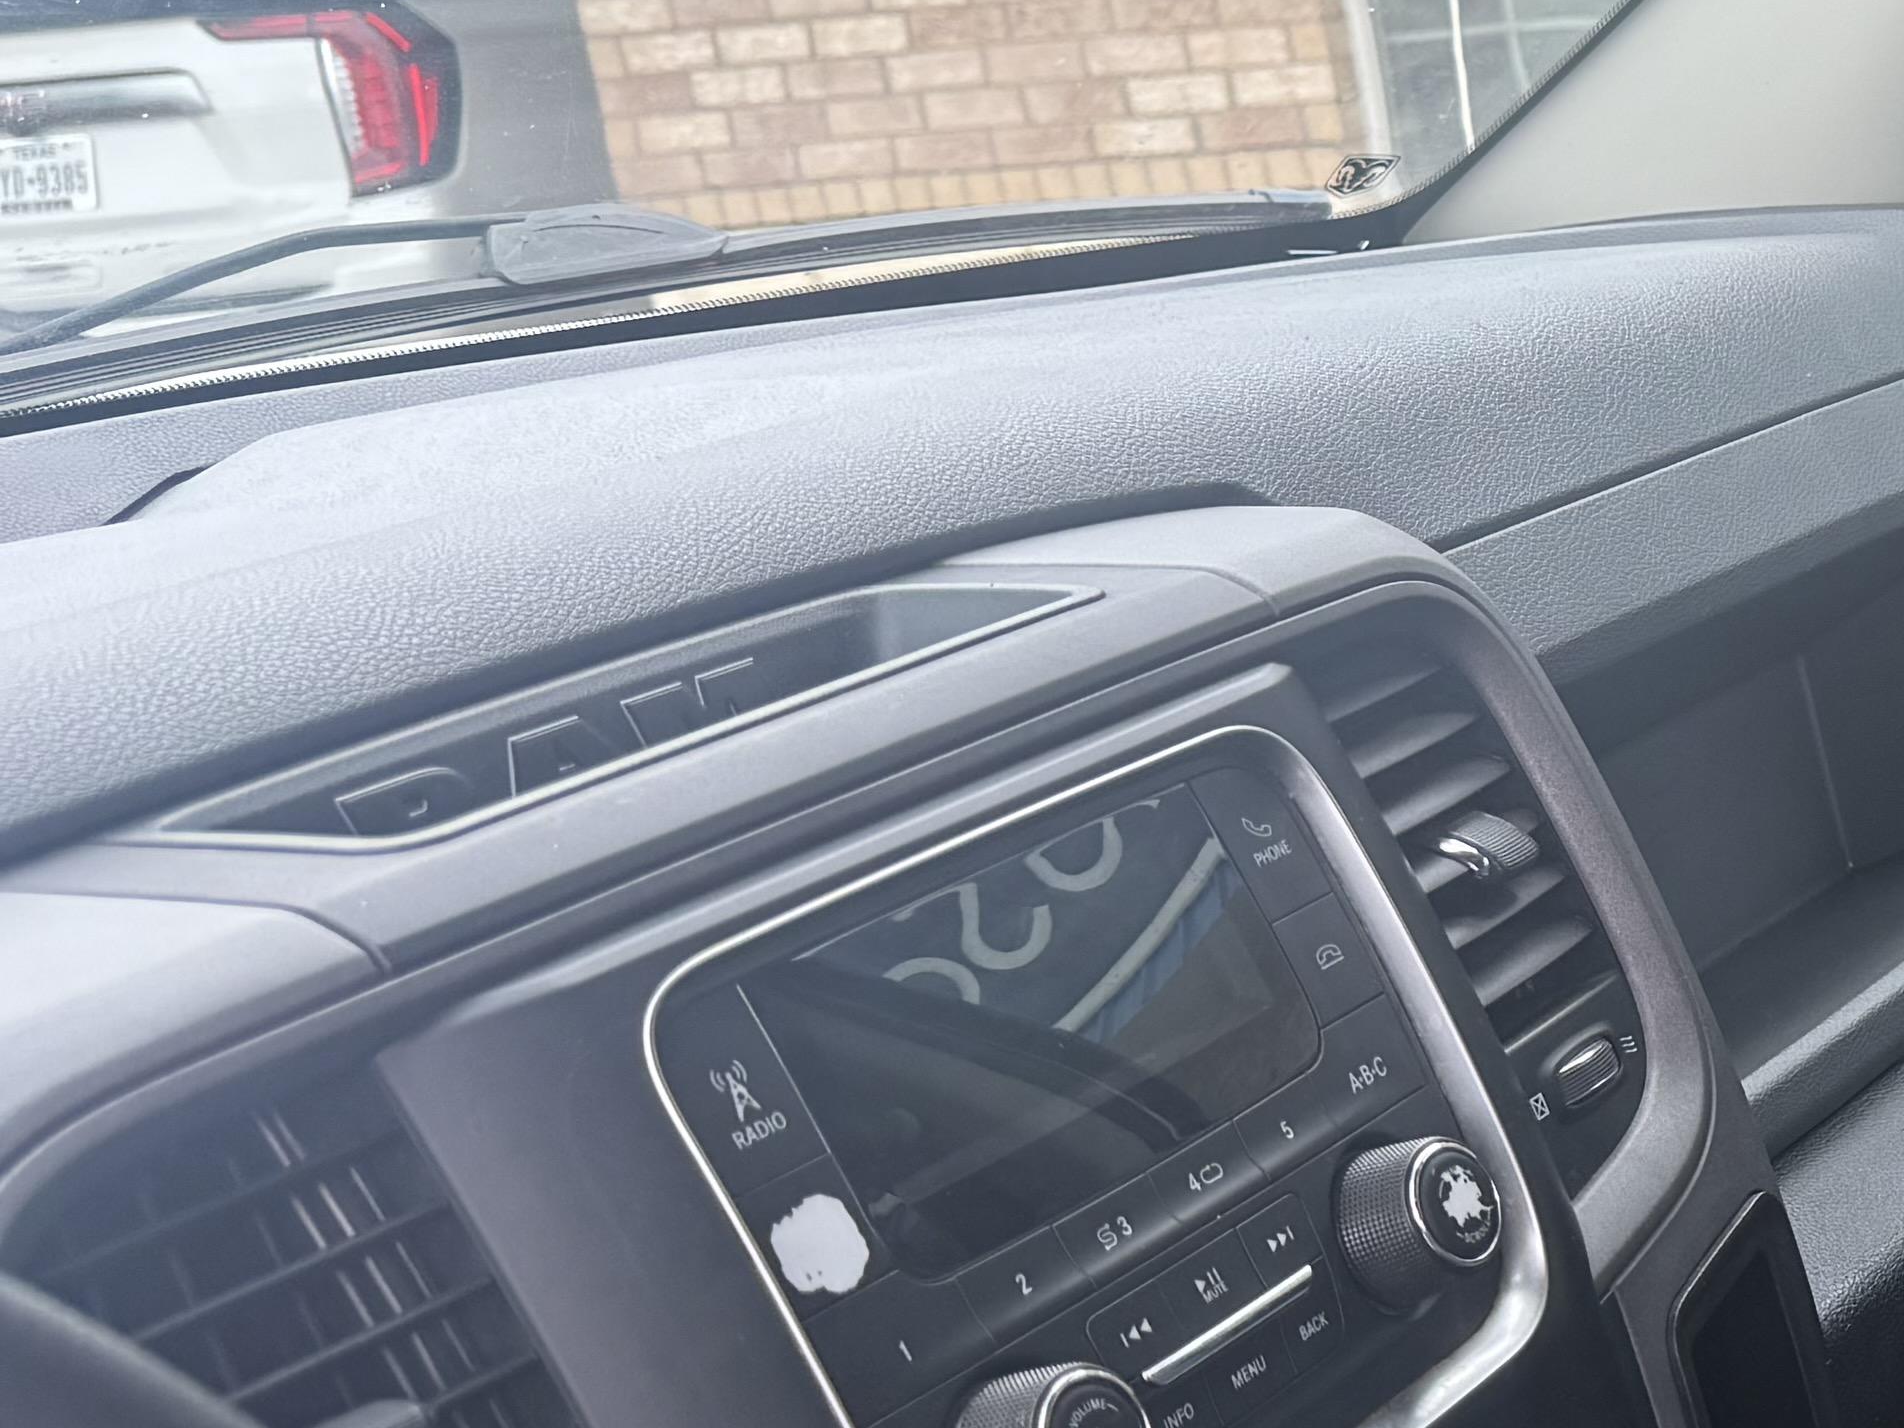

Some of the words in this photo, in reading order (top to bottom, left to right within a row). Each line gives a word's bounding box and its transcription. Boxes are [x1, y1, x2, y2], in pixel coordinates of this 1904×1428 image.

[335, 656, 765, 838] RAM
[1253, 840, 1292, 867] PHONE
[731, 1112, 787, 1150] RADIO
[1279, 1121, 1295, 1139] 5
[1187, 1173, 1202, 1192] 4
[1116, 1216, 1133, 1236] 3
[1015, 1273, 1032, 1295] 2
[1202, 1281, 1229, 1304] MUTE
[1298, 1311, 1330, 1341] BACK
[899, 1339, 913, 1362] 1
[1231, 1355, 1267, 1390] MENU
[1068, 1398, 1107, 1428] VOLUME
